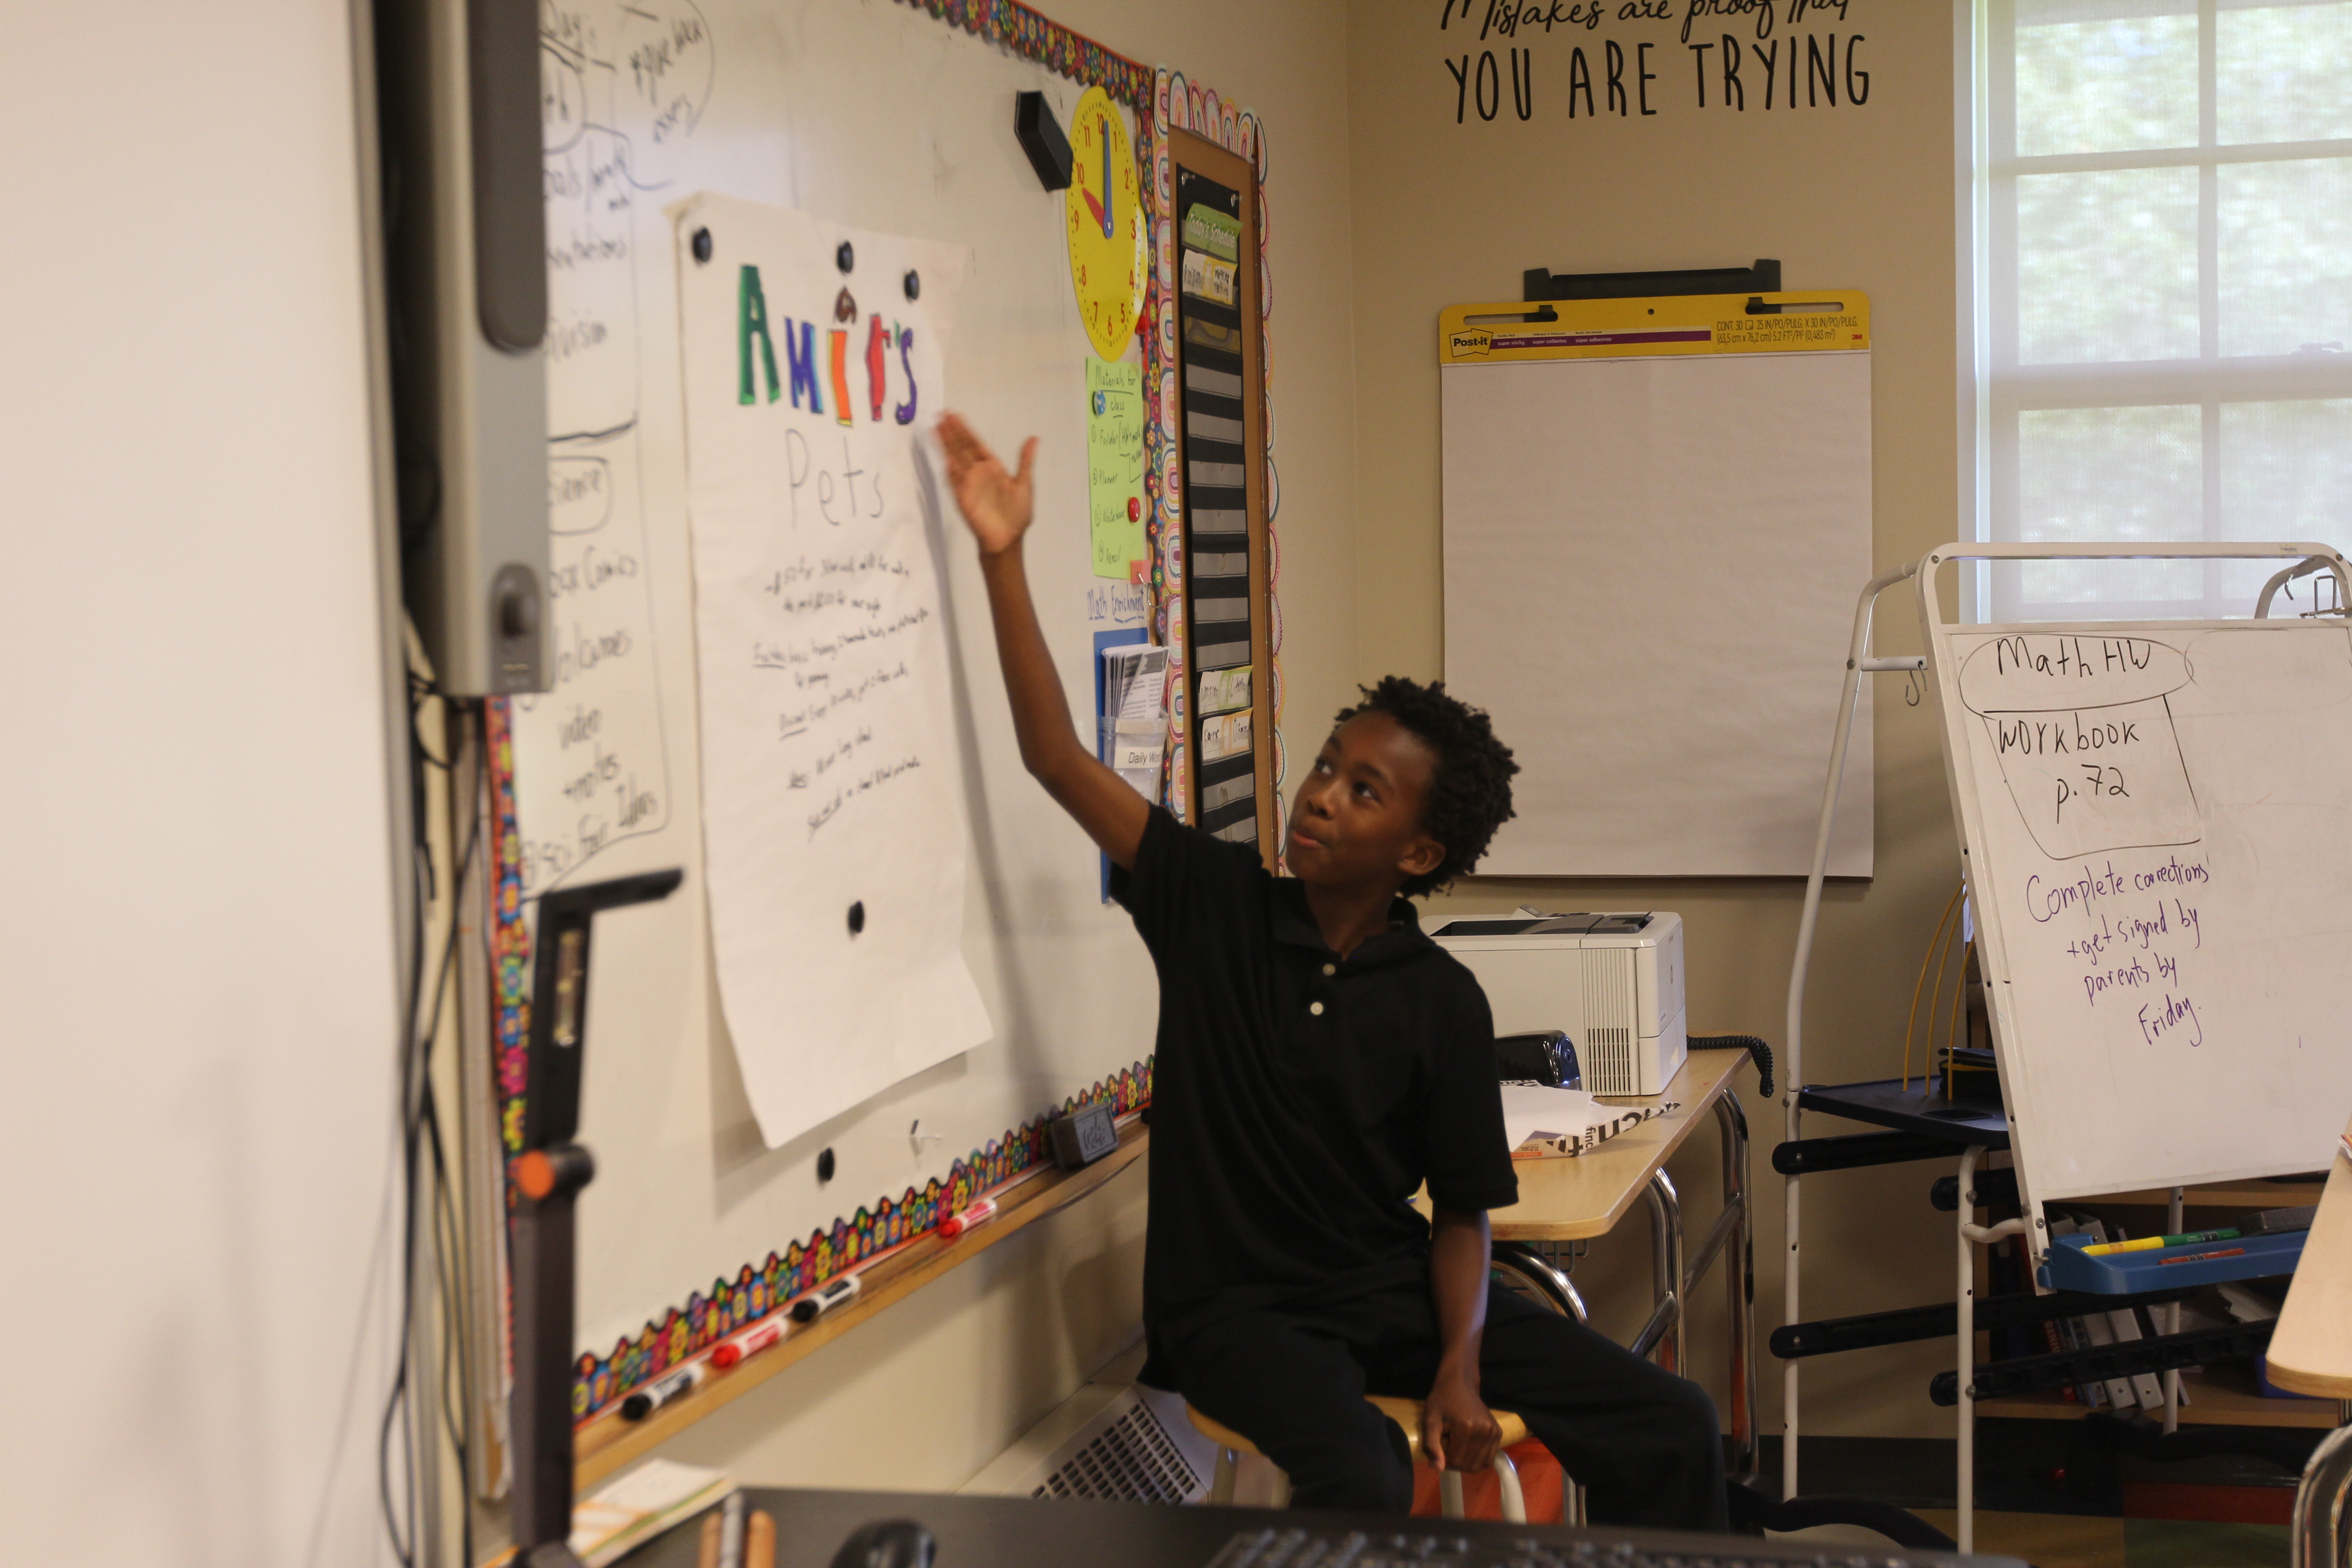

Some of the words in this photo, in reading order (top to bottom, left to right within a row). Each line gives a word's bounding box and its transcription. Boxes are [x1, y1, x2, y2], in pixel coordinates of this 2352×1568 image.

[1441, 0, 1604, 40] Mistakes
[1619, 0, 1672, 20] are
[1681, 0, 1775, 44] proof
[1445, 47, 1532, 124] YOU
[1569, 40, 1657, 118] ARE
[1689, 34, 1870, 111] TRYING
[1076, 162, 1084, 185] 10
[1188, 213, 1210, 240] Today's
[1210, 223, 1235, 248] Schedule
[1732, 334, 1741, 343] cm
[1736, 320, 1743, 330] 30
[1757, 319, 1764, 329] 25
[1811, 318, 1818, 327] 30
[1453, 336, 1489, 347] Post-it
[1096, 364, 1124, 388] Materials
[1111, 395, 1124, 411] class
[1100, 429, 1118, 445] Folder
[785, 428, 884, 531] Pets
[1088, 586, 1107, 616] Math
[1112, 583, 1144, 616] Enrichment
[1997, 636, 2092, 677] Math
[2103, 640, 2151, 673] HW
[1129, 752, 1147, 765] Daily
[2026, 861, 2125, 922] Complete
[2135, 855, 2209, 891] corrections
[2117, 900, 2168, 949] signed
[2176, 898, 2200, 949] by
[2084, 956, 2150, 1007] parents
[2154, 953, 2178, 987] by
[2138, 994, 2202, 1047] Friday
[1585, 1127, 1596, 1151] finc
